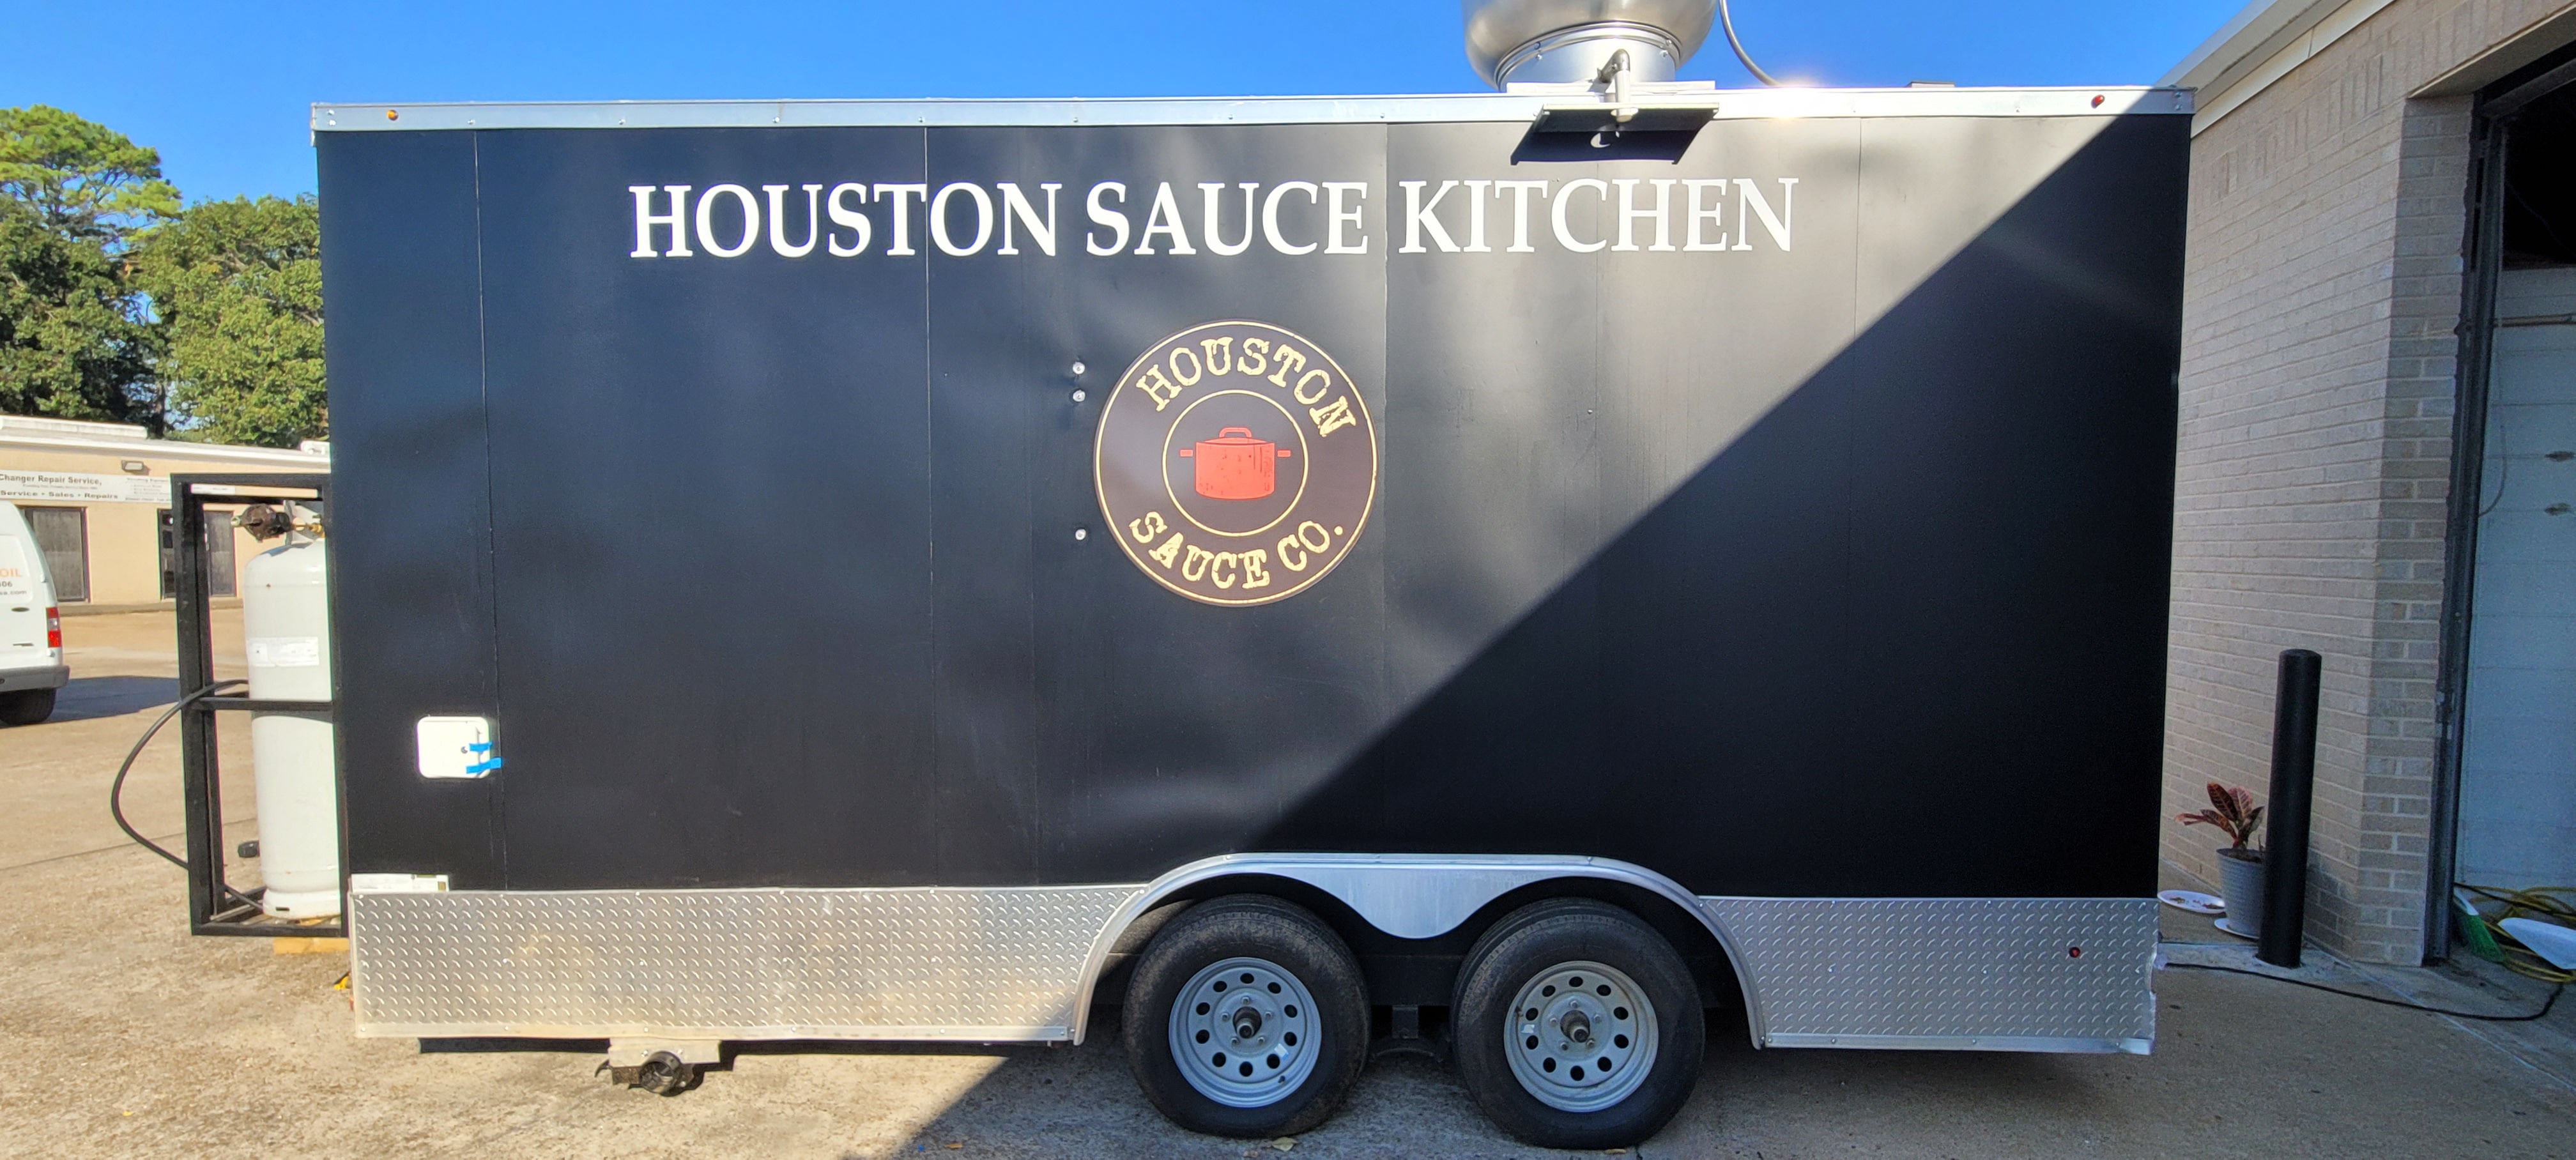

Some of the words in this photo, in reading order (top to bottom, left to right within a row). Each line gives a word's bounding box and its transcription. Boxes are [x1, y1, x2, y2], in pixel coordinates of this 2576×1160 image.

[629, 181, 1062, 258] HOUSTON
[1086, 180, 1368, 256] SAUCE
[1399, 178, 1799, 254] KITCHEN
[1136, 337, 1356, 438] HOUSTON
[0, 474, 34, 484] Changer
[38, 475, 65, 484] Repair
[68, 477, 102, 485] Service,
[0, 568, 22, 577] OIL
[1129, 512, 1270, 589] SAUCE
[1277, 521, 1344, 572] CO.
